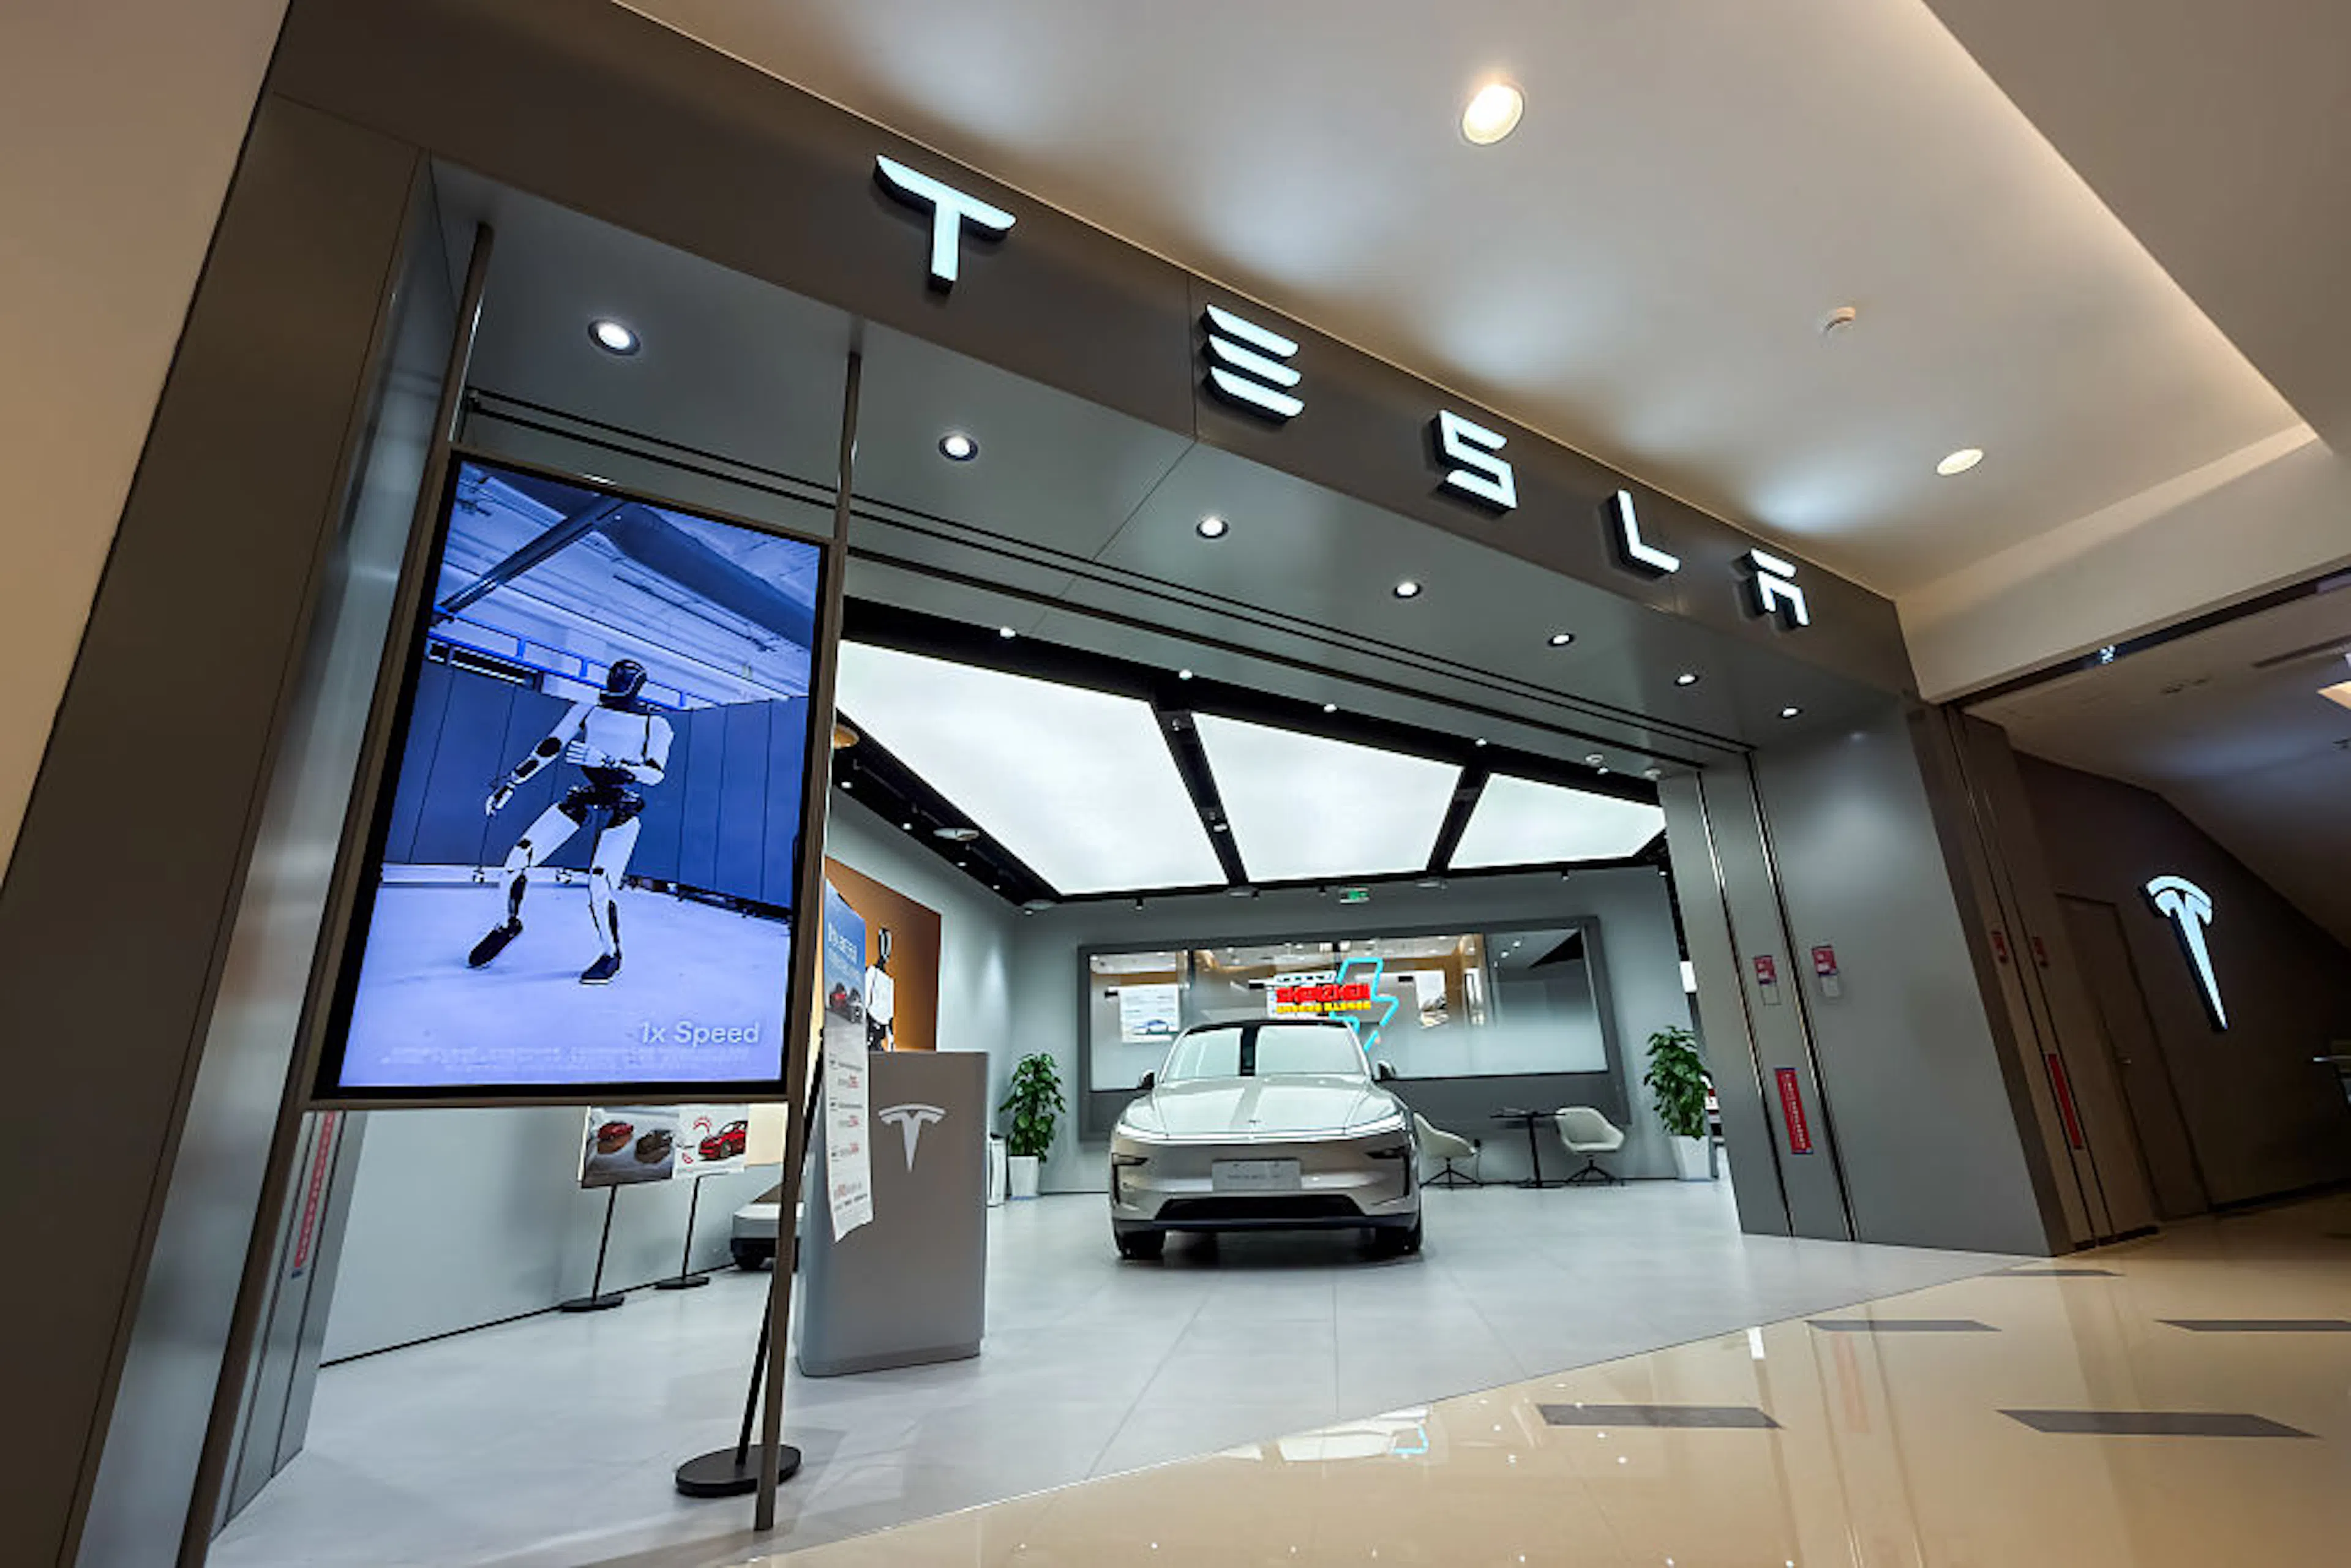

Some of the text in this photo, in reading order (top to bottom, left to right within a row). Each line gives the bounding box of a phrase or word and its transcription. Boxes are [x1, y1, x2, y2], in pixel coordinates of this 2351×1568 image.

[876, 154, 1810, 626] TESLA
[642, 1020, 759, 1048] 1x Speed
